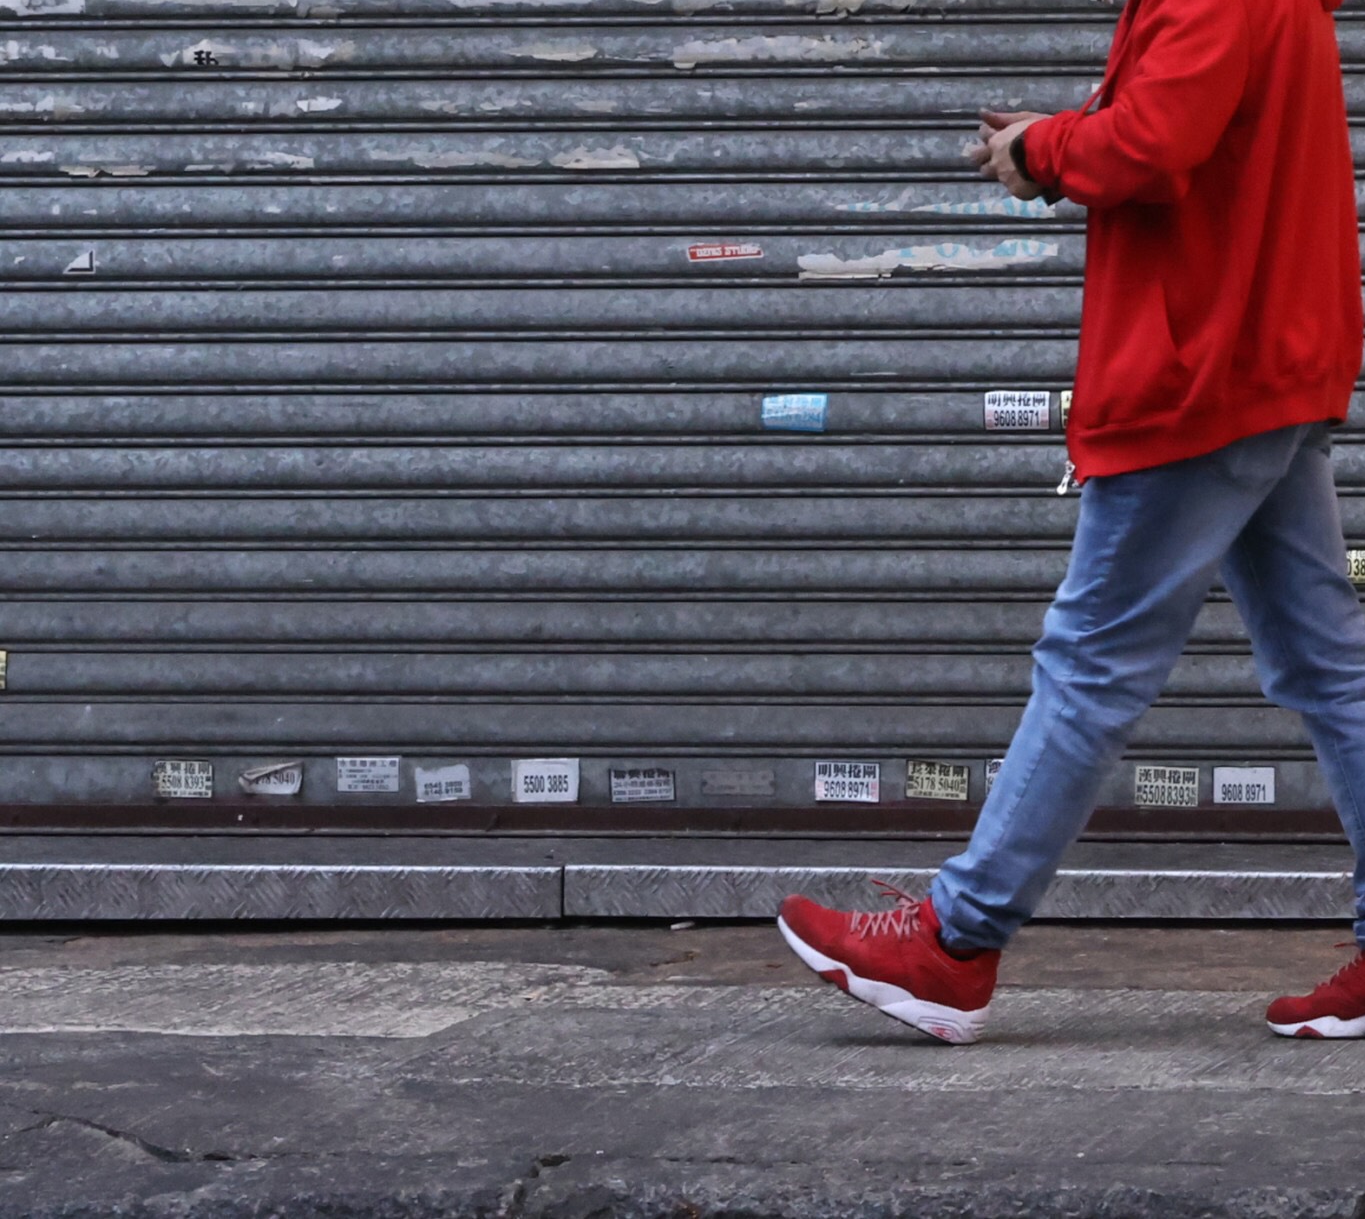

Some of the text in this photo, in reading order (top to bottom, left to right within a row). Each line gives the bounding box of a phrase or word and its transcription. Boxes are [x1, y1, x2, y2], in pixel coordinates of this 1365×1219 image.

[994, 410, 1040, 427] 9608 8971
[817, 764, 877, 778] 明興捲閘
[1138, 768, 1196, 784] 漢興捲閘
[161, 775, 205, 790] 5508 8393
[523, 774, 569, 793] 5500 3885
[824, 781, 870, 798] 9608 8971
[913, 776, 961, 792] 5178 5040
[1142, 785, 1190, 805] 5508 8393
[1221, 783, 1266, 801] 9608 8971
